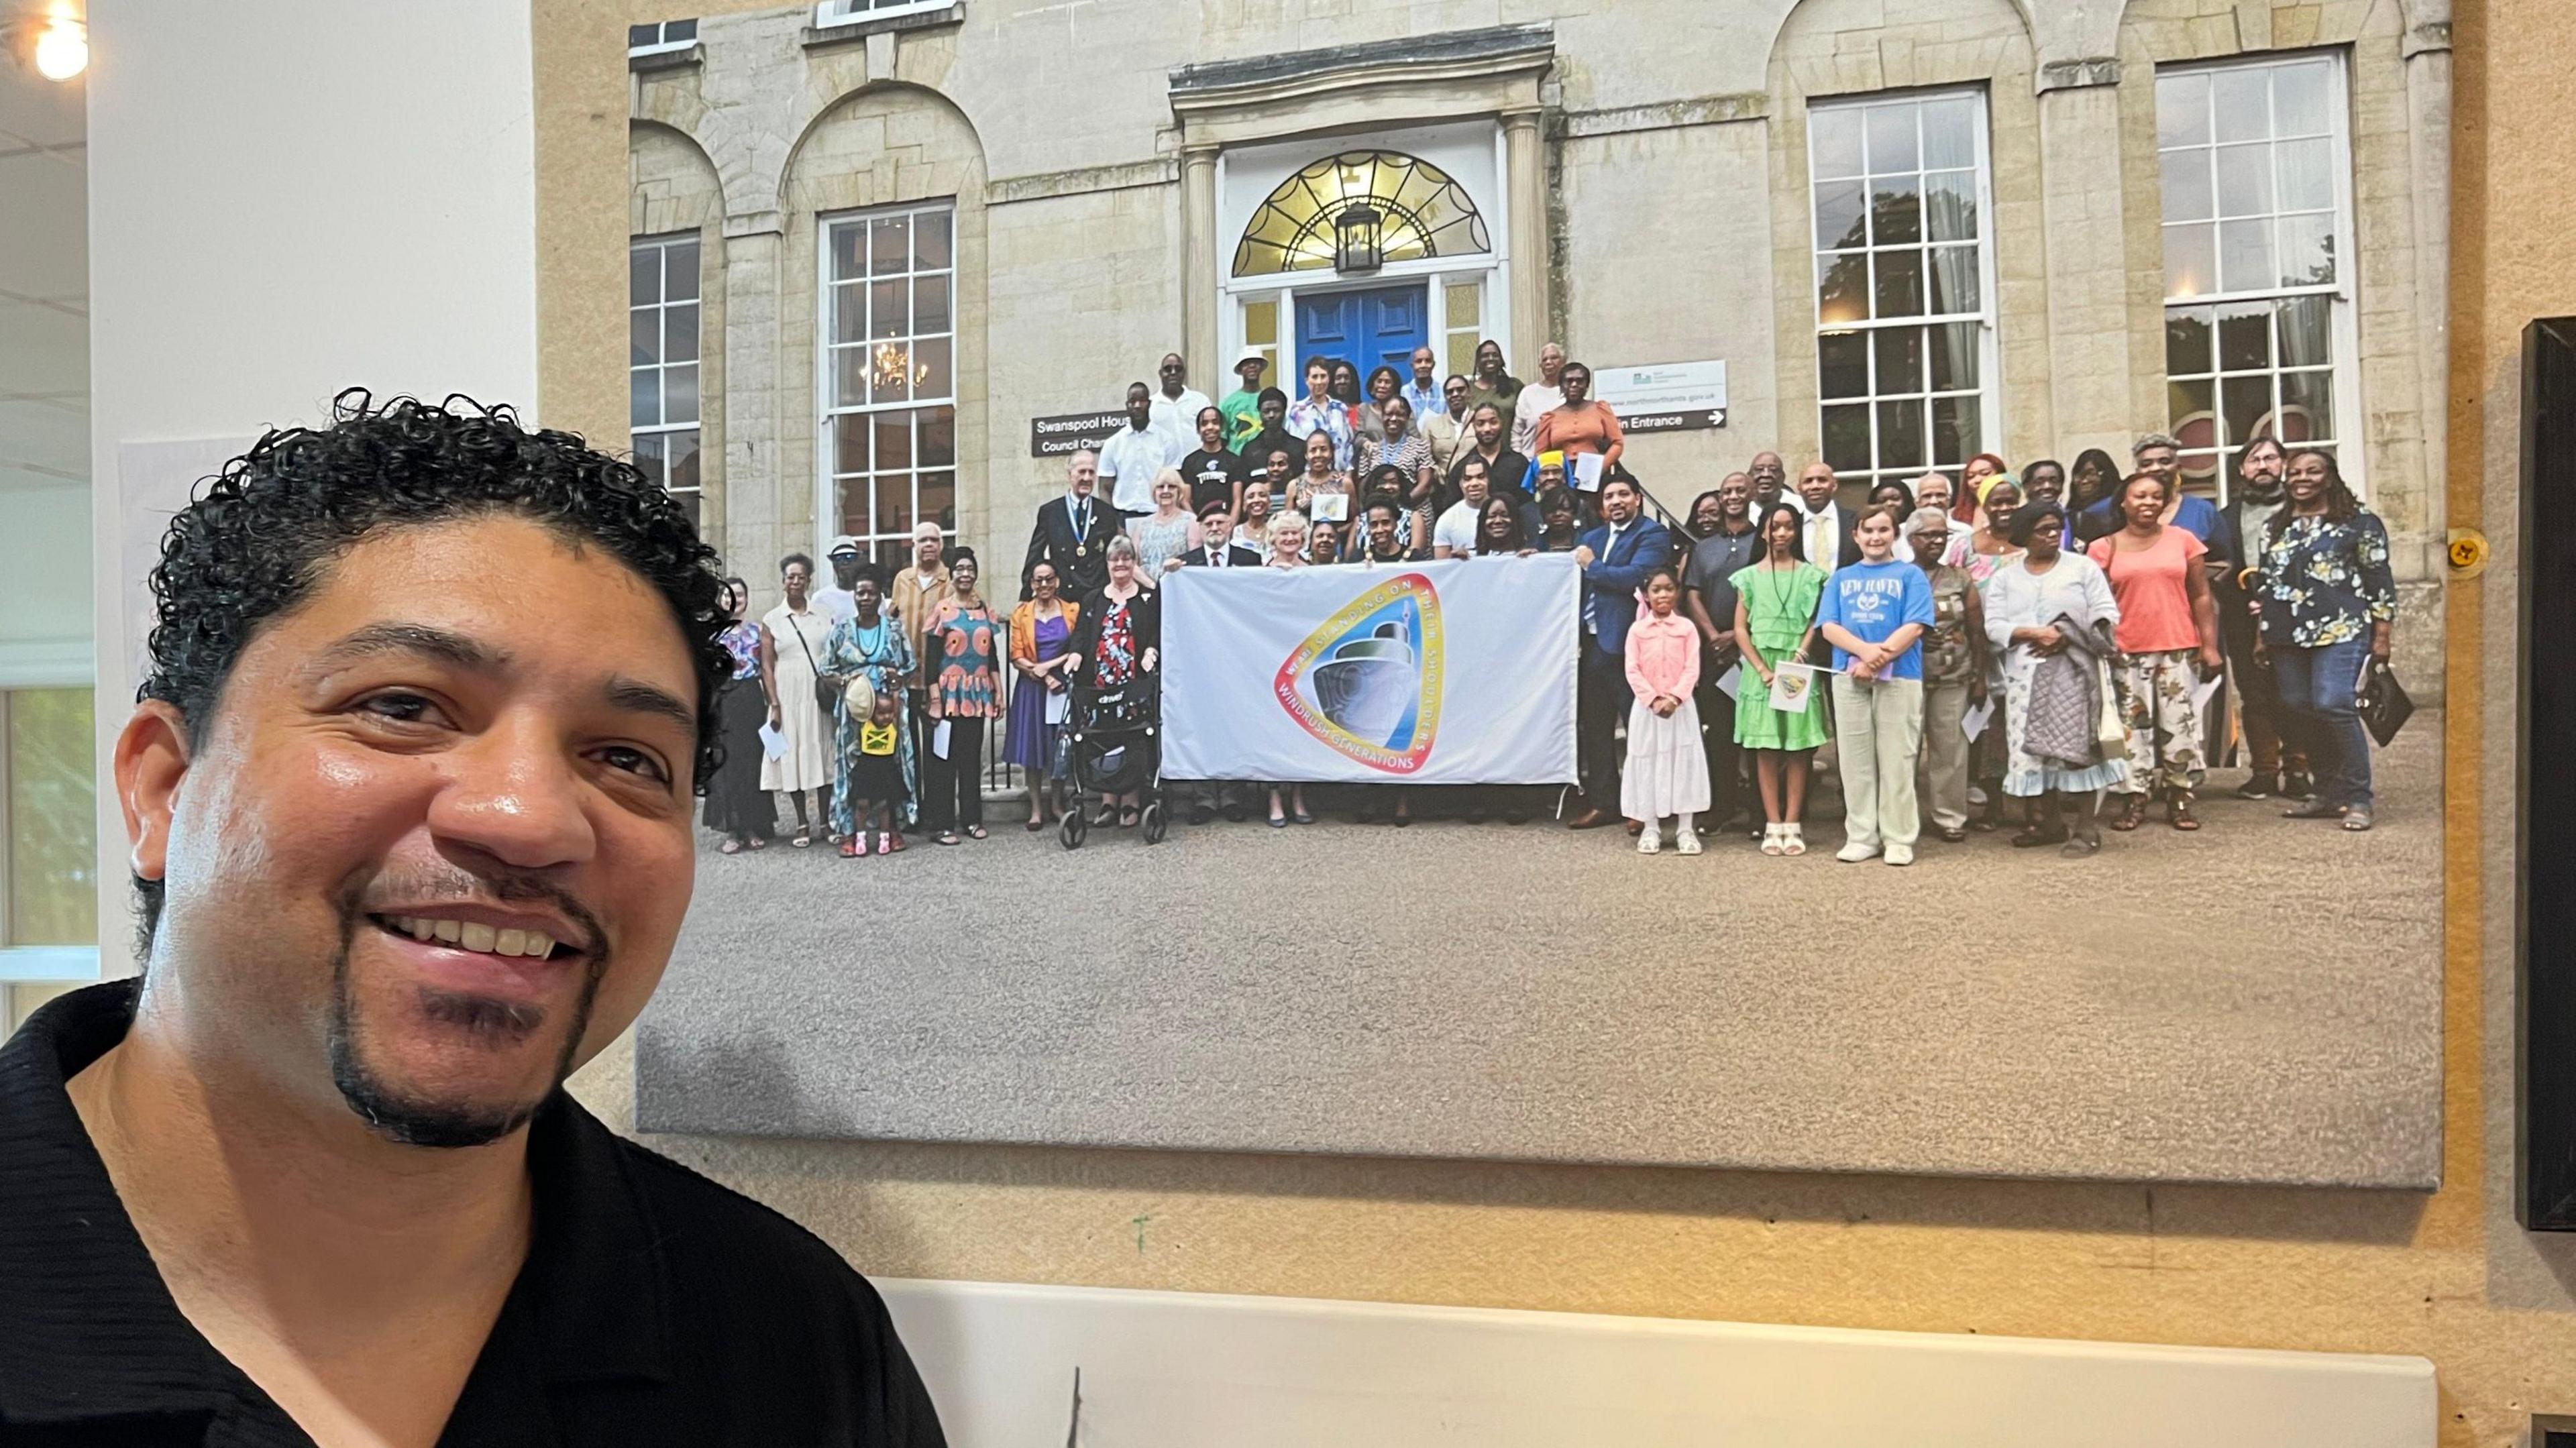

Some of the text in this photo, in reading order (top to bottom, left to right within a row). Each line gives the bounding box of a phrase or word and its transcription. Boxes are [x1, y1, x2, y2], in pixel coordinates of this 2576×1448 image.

[1036, 416, 1131, 433] Swanspool Hous
[1617, 416, 1683, 429] in Entrance
[1042, 439, 1079, 452] Council
[1866, 579, 1903, 601] HAVEN
[1316, 593, 1384, 646] STANDING
[1389, 579, 1411, 595] ON
[1415, 649, 1437, 751] SHOULDERS
[1278, 682, 1414, 769] WINDRUSH GENERATIONS
